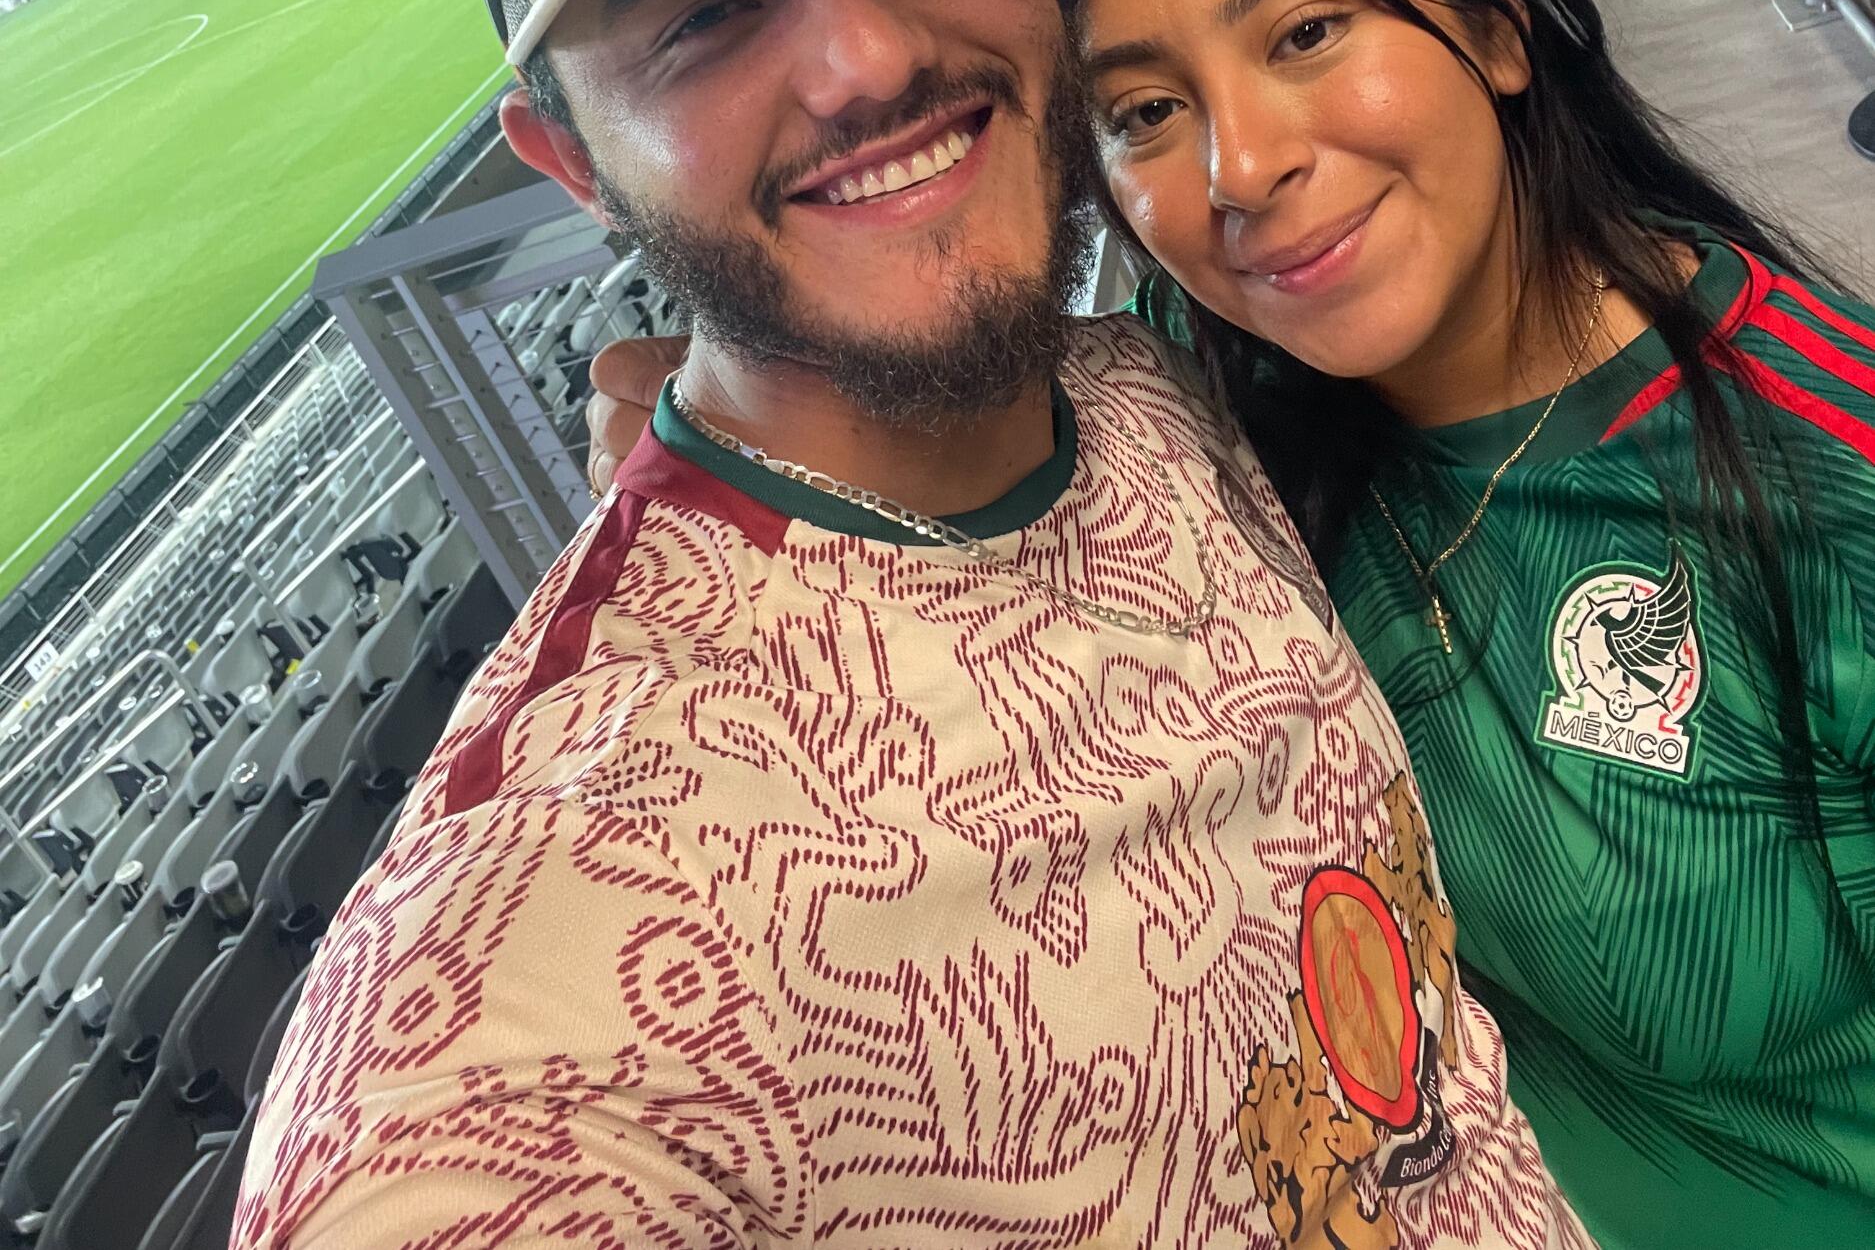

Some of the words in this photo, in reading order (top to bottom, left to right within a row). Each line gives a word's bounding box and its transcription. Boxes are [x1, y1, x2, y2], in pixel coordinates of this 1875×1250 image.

[33, 651, 52, 672] 143
[1549, 710, 1684, 765] MÉXICO
[1400, 1145, 1444, 1179] Biondo
[1426, 1068, 1438, 1100] Inc
